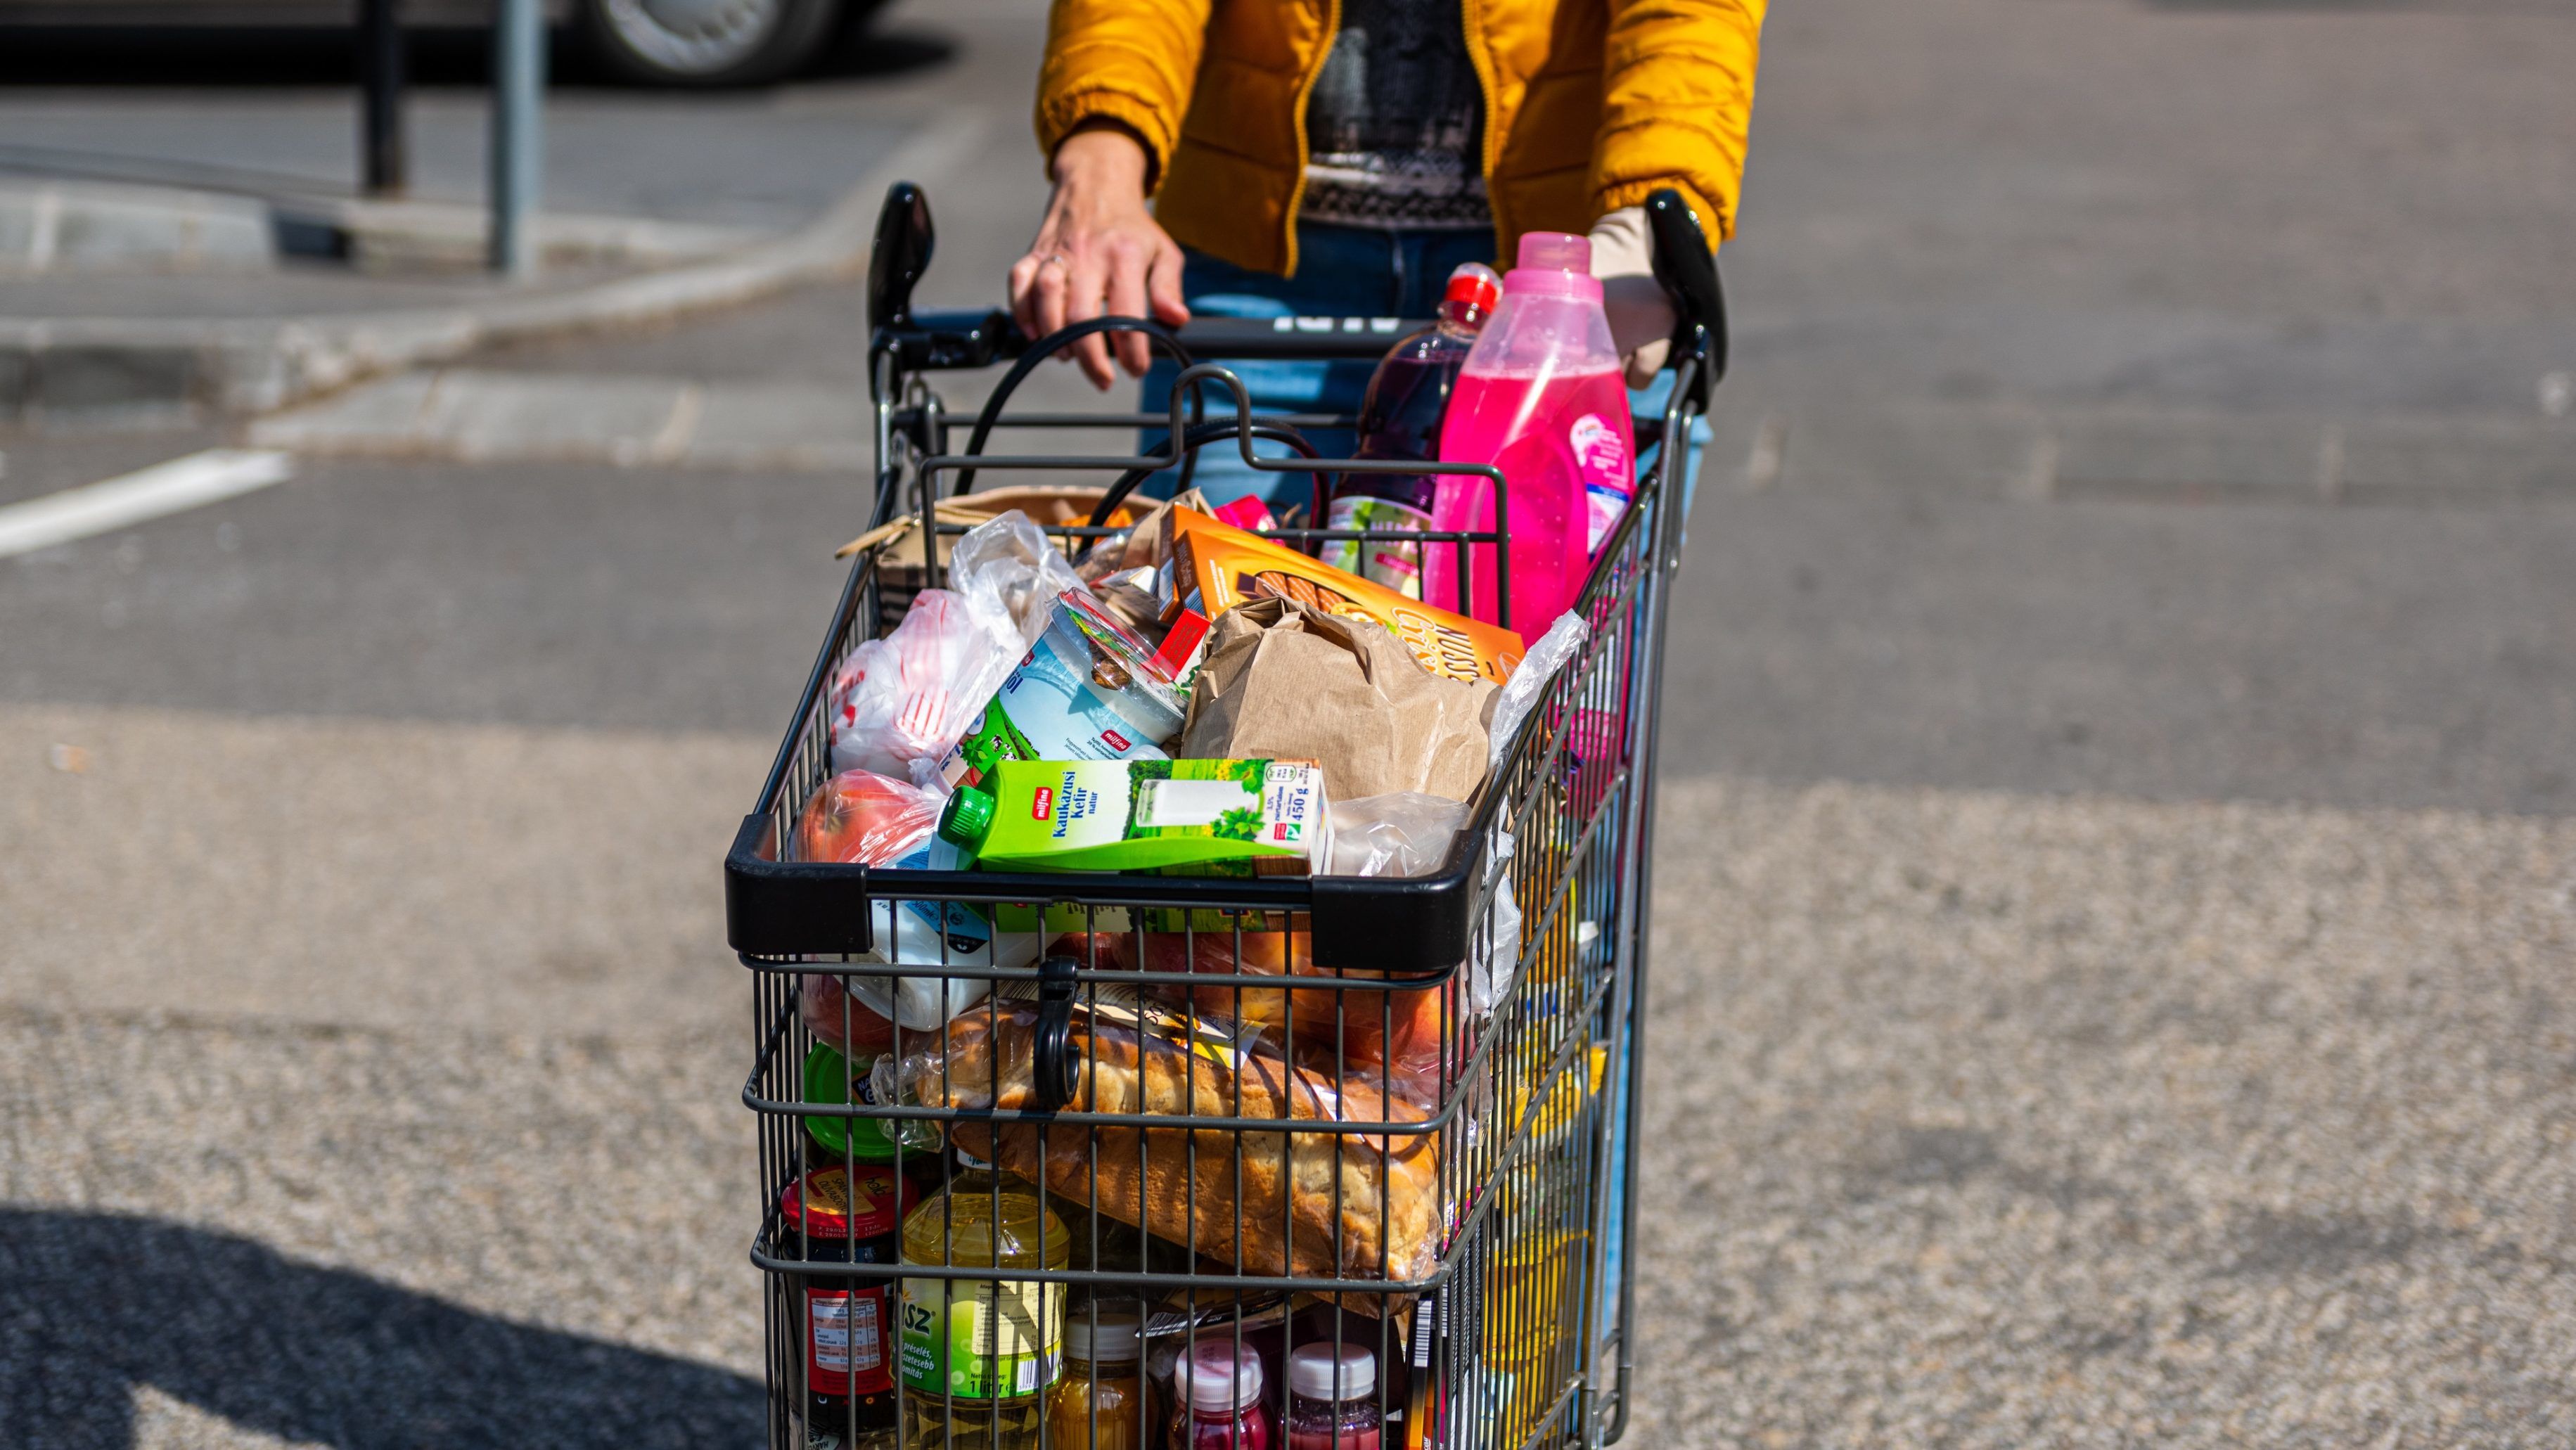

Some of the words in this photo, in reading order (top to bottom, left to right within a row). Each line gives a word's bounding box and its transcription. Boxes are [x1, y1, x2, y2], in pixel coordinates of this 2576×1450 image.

[1392, 607, 1438, 674] Cris
[1435, 624, 1480, 681] NUSS
[1105, 732, 1127, 750] milfina
[1037, 790, 1049, 817] milfina
[1052, 771, 1075, 838] Kaukázusi
[1070, 788, 1087, 819] Kefir
[1088, 792, 1098, 814] natur
[1292, 798, 1305, 821] 450
[903, 1342, 933, 1360] préselés,
[902, 1365, 923, 1379] omítás
[970, 1380, 976, 1393] 1
[980, 1380, 1004, 1393] litr
